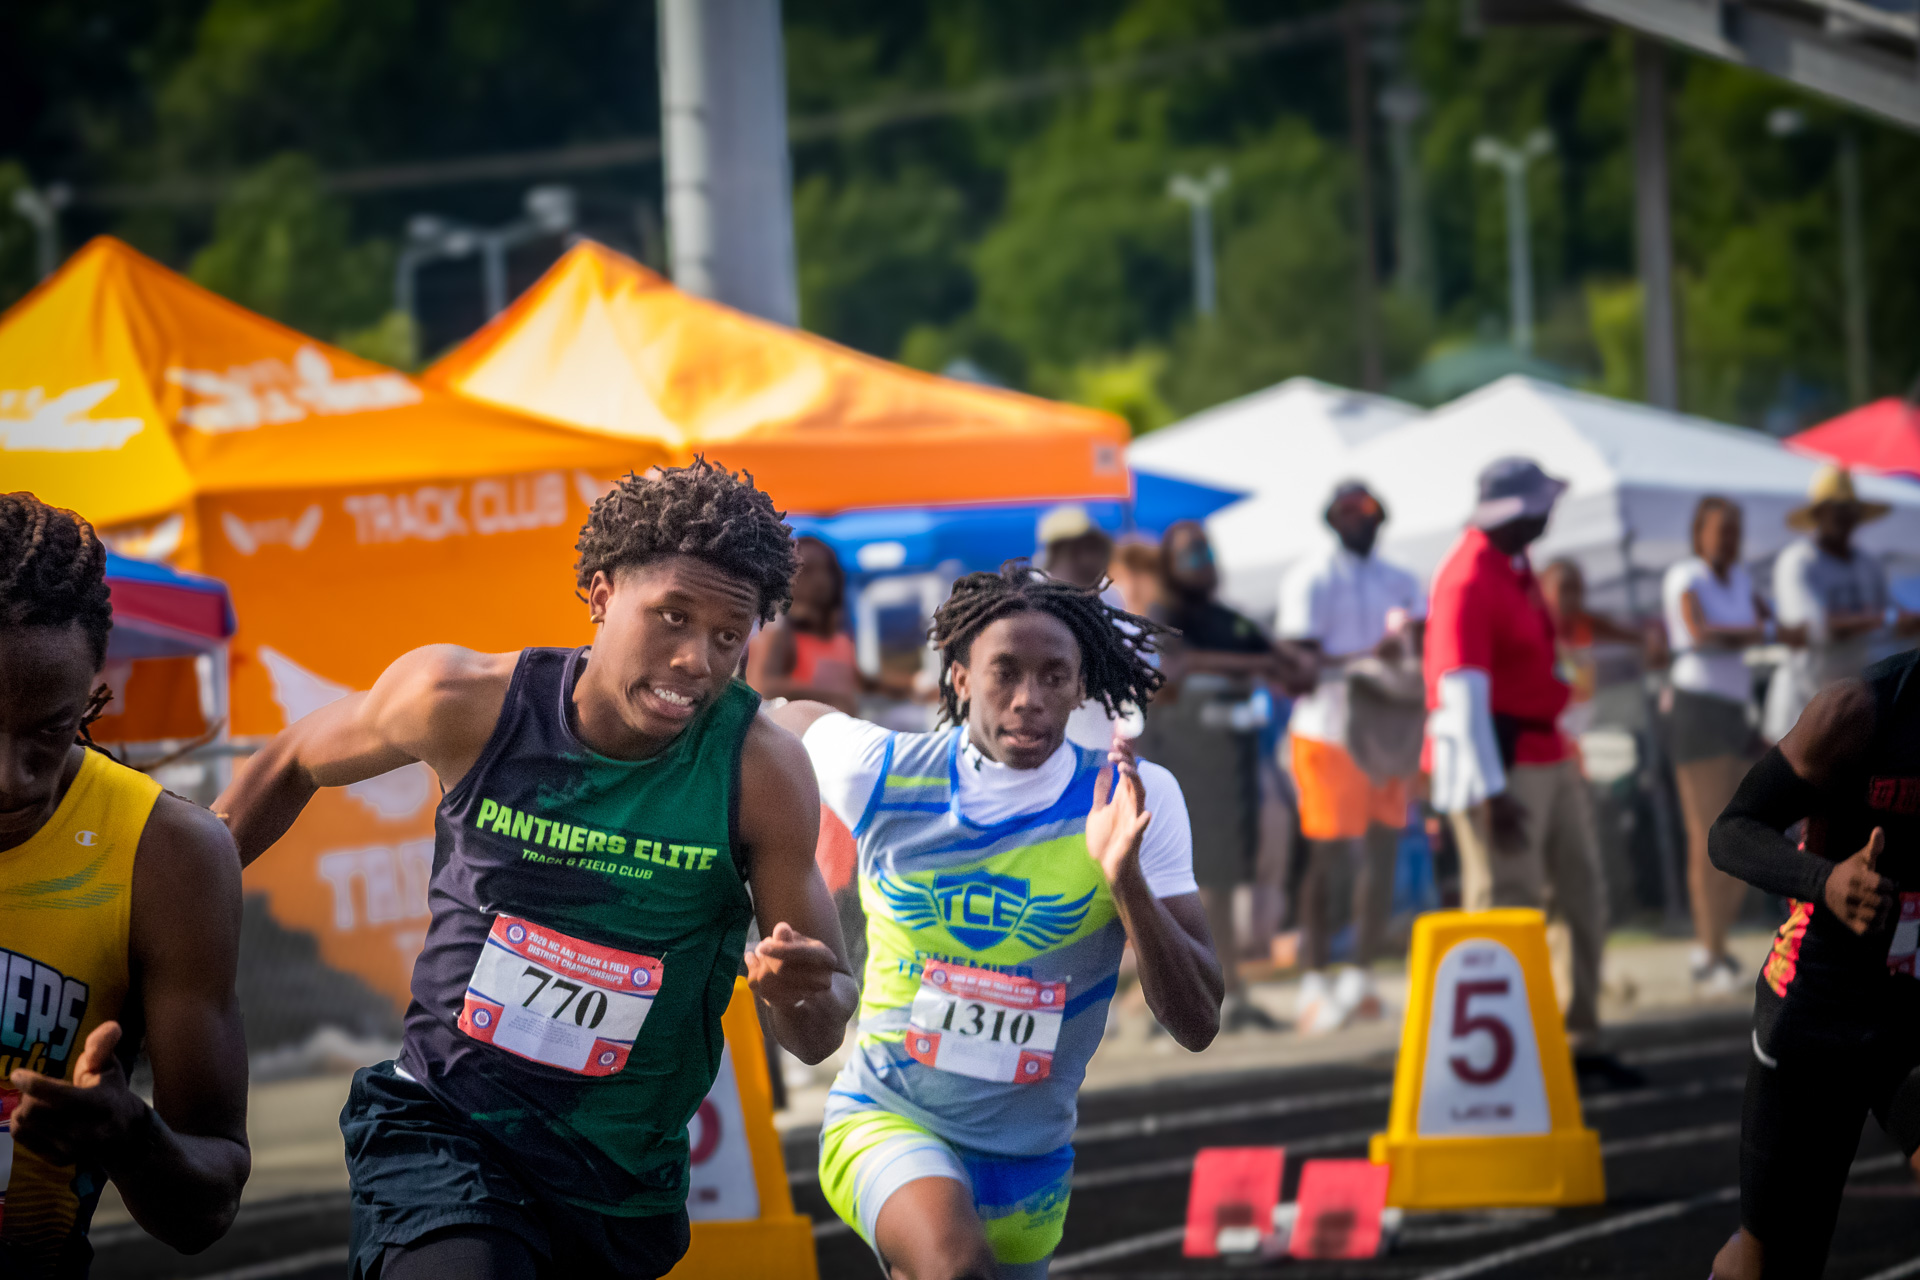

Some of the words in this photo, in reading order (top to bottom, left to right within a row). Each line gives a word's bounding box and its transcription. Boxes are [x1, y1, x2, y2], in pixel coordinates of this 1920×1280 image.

[344, 486, 469, 545] TRACK
[471, 472, 566, 535] CLUB
[476, 798, 626, 854] PANTHERS
[634, 839, 718, 870] ELITE
[522, 848, 563, 865] TRACK
[566, 857, 576, 866] &
[578, 858, 617, 874] FIELD
[618, 865, 653, 880] CLUB
[937, 883, 1023, 928] TCE
[527, 943, 561, 964] DISTRICT
[561, 958, 624, 984] CHAMPIONSHIPS
[548, 940, 560, 952] NC
[560, 946, 577, 959] AAU
[577, 953, 601, 968] TRACK
[601, 960, 608, 970] &
[609, 961, 630, 974] FIELD
[521, 965, 608, 1029] 770
[942, 1000, 1035, 1045] 1310
[1448, 979, 1516, 1086] 5
